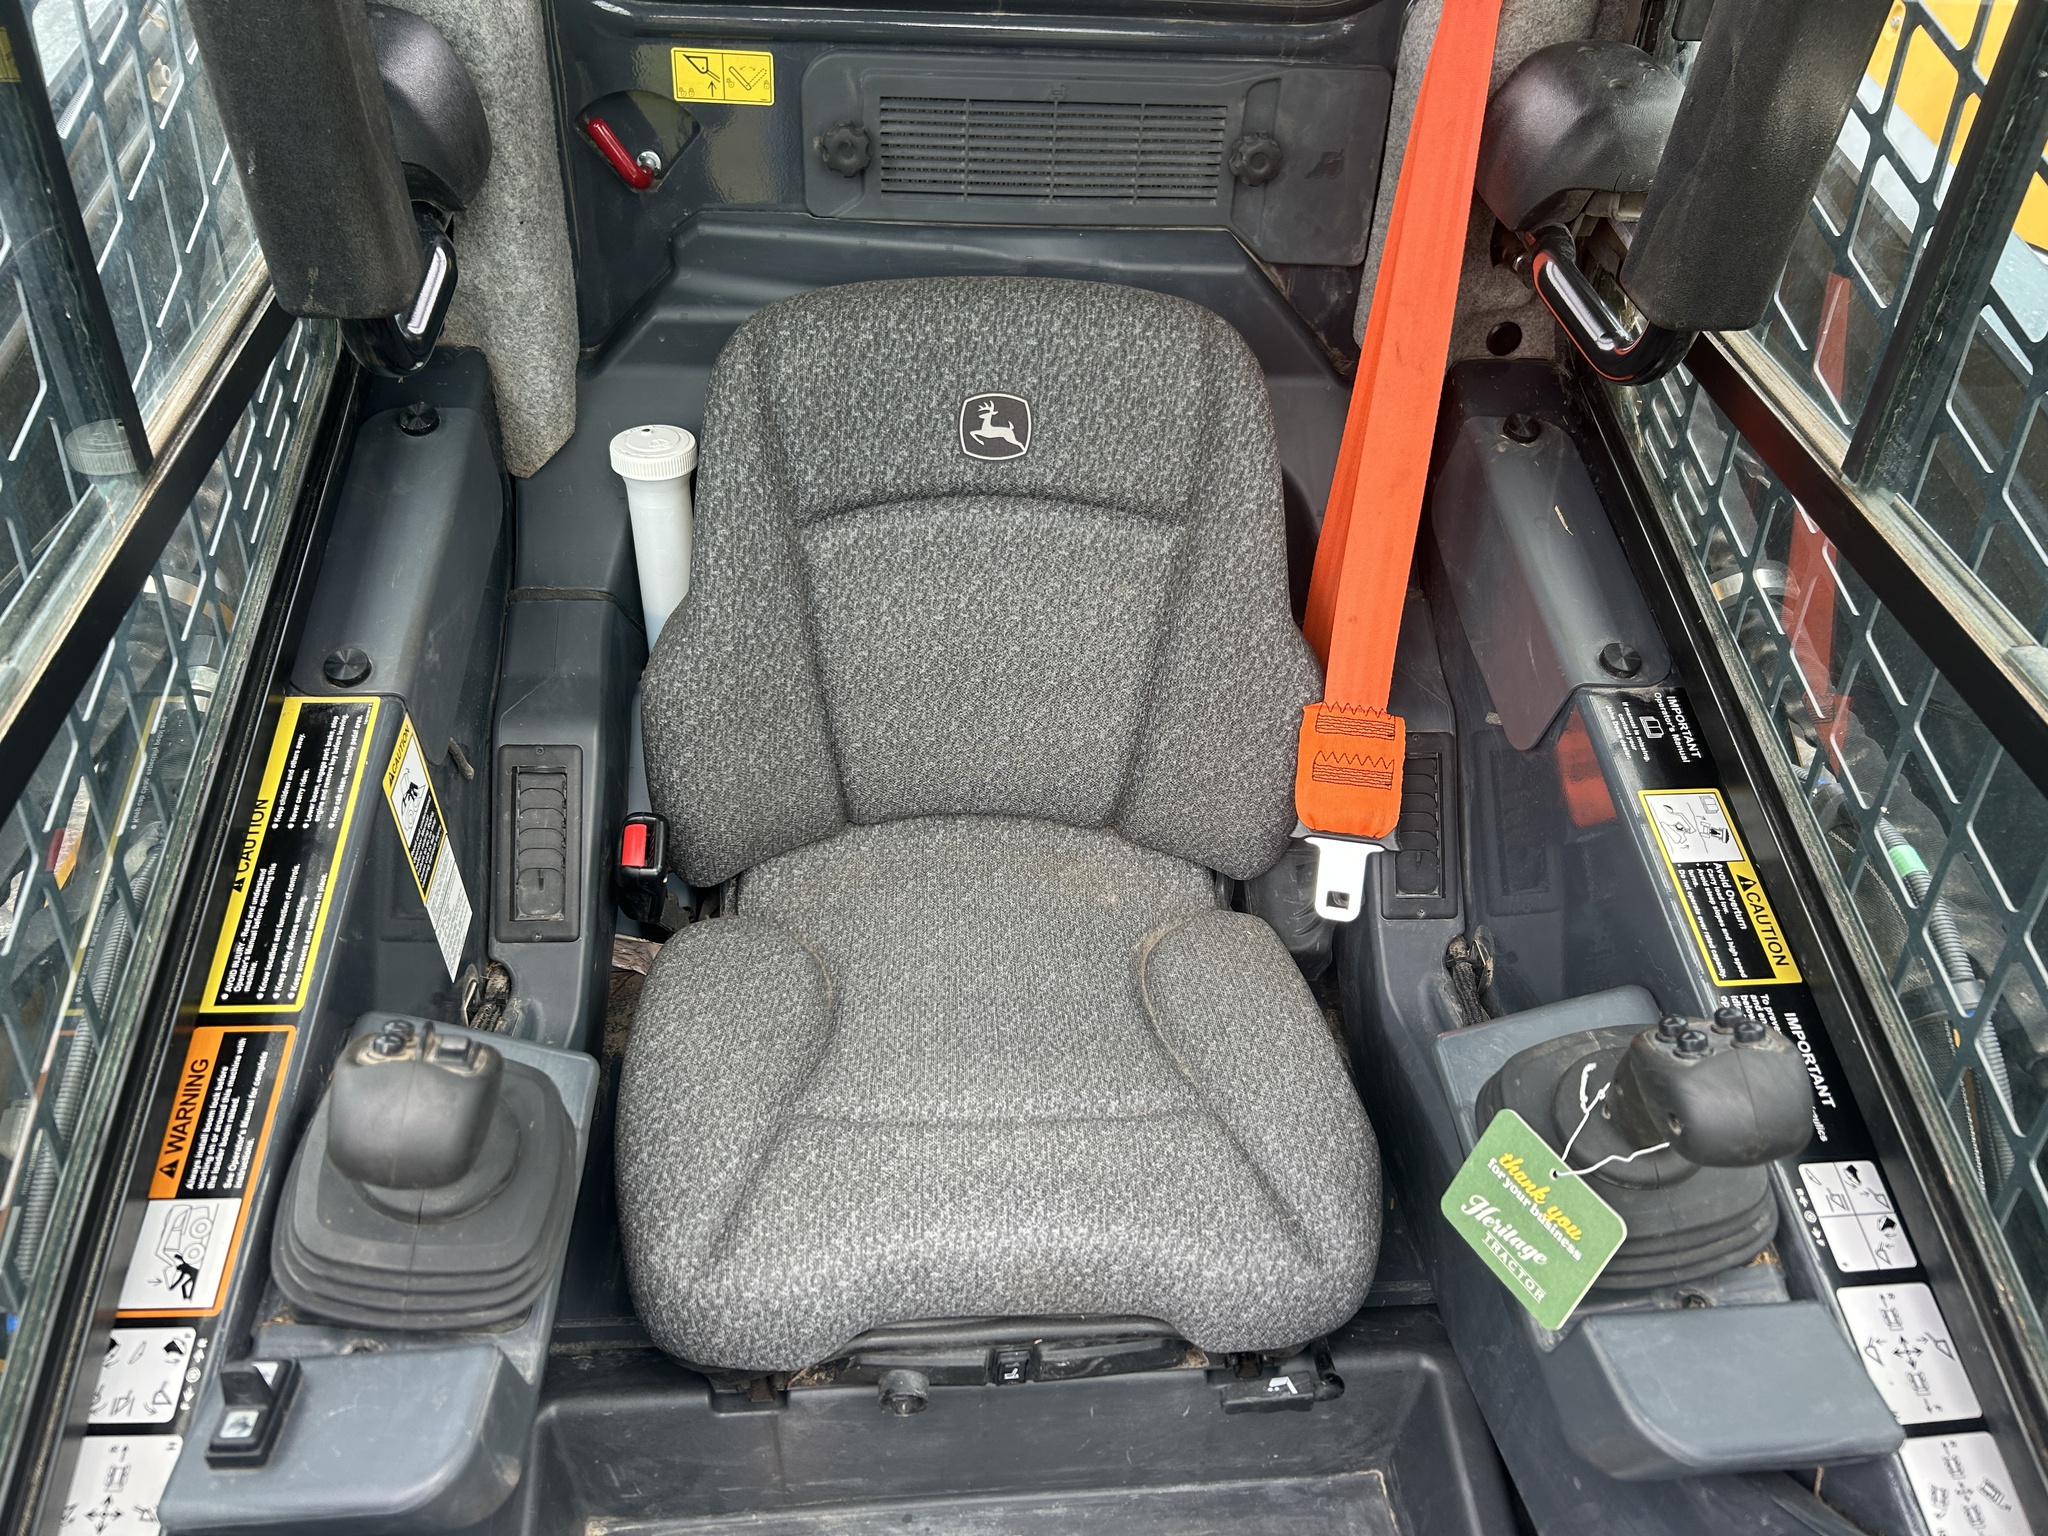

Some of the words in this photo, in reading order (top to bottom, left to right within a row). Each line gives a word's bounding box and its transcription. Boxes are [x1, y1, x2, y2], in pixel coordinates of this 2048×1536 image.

[1624, 707, 1638, 729] manual
[1653, 692, 1675, 732] Operator's
[1671, 734, 1691, 763] Manual
[1666, 696, 1701, 757] IMPORTANT
[296, 733, 306, 749] away.
[1616, 713, 1632, 736] contact
[1626, 736, 1637, 751] your
[290, 750, 300, 769] others
[391, 725, 411, 771] CAUTION
[287, 769, 295, 781] and
[299, 768, 310, 787] riders.
[279, 781, 292, 805] children
[295, 788, 306, 804] carry
[273, 806, 285, 822] Keep
[289, 804, 300, 822] Never
[251, 868, 267, 905] understand
[287, 863, 301, 892] controls.
[317, 872, 328, 892] place.
[1688, 869, 1699, 887] turns.
[285, 892, 293, 900] of
[314, 892, 322, 900] in
[1706, 868, 1717, 885] Carry
[1714, 886, 1724, 900] load
[1720, 901, 1729, 914] low.
[1713, 863, 1731, 888] Avoid
[1725, 890, 1747, 929] Overturn
[247, 906, 256, 918] and
[276, 900, 290, 928] function
[294, 895, 309, 923] working.
[307, 900, 321, 929] windows
[233, 956, 251, 992] Operator's
[244, 930, 258, 955] Manual
[252, 908, 264, 929] before
[259, 876, 275, 907] operating
[267, 863, 277, 876] this
[240, 920, 252, 937] Read
[273, 929, 283, 942] and
[1678, 869, 1686, 878] Do
[1682, 879, 1692, 890] not
[1687, 892, 1701, 914] operate
[1697, 916, 1708, 930] over
[1703, 932, 1716, 947] rated
[1711, 950, 1727, 978] capacity.
[1697, 868, 1709, 886] Avoid
[1705, 888, 1716, 904] steep
[1712, 906, 1725, 927] slopes
[1721, 928, 1732, 940] and
[1727, 942, 1738, 955] high
[1733, 958, 1748, 978] speed
[1746, 892, 1790, 966] CAUTION
[286, 924, 300, 950] devices
[304, 930, 313, 944] and
[231, 942, 245, 968] INJURY
[264, 943, 279, 971] location
[281, 951, 294, 972] safety
[296, 945, 309, 972] screens
[224, 969, 238, 992] AVOID
[244, 960, 258, 992] machine.
[258, 971, 271, 992] Know
[274, 973, 287, 991] Keep
[289, 972, 302, 992] Keep
[1750, 994, 1764, 1011] and
[1760, 994, 1770, 1005] To
[237, 1038, 247, 1054] with
[227, 1055, 242, 1087] machine
[253, 1051, 269, 1086] complete
[1784, 1012, 1836, 1108] IMPORTANT
[214, 1066, 229, 1091] before
[209, 1092, 221, 1109] lock
[221, 1088, 232, 1104] this
[248, 1087, 259, 1099] for
[164, 1059, 209, 1155] WARNING
[214, 1104, 228, 1133] around
[227, 1096, 240, 1123] raised.
[240, 1100, 255, 1128] Manual
[202, 1109, 216, 1133] boom
[195, 1133, 209, 1158] install
[211, 1133, 219, 1143] or
[219, 1124, 232, 1147] boom
[207, 1144, 216, 1155] on
[211, 1148, 225, 1174] loader
[227, 1129, 248, 1172] Operator's
[185, 1159, 202, 1190] Always
[197, 1156, 215, 1190] working
[233, 1138, 255, 1189] instructions.
[207, 1175, 218, 1190] the
[222, 1172, 235, 1189] See
[1487, 1157, 1506, 1179] for
[1502, 1177, 1532, 1206] your
[1529, 1202, 1582, 1261] business
[1499, 1152, 1551, 1205] thank
[1542, 1204, 1582, 1242] you
[1461, 1194, 1547, 1265] Heritage
[1483, 1232, 1546, 1302] TRACTOR
